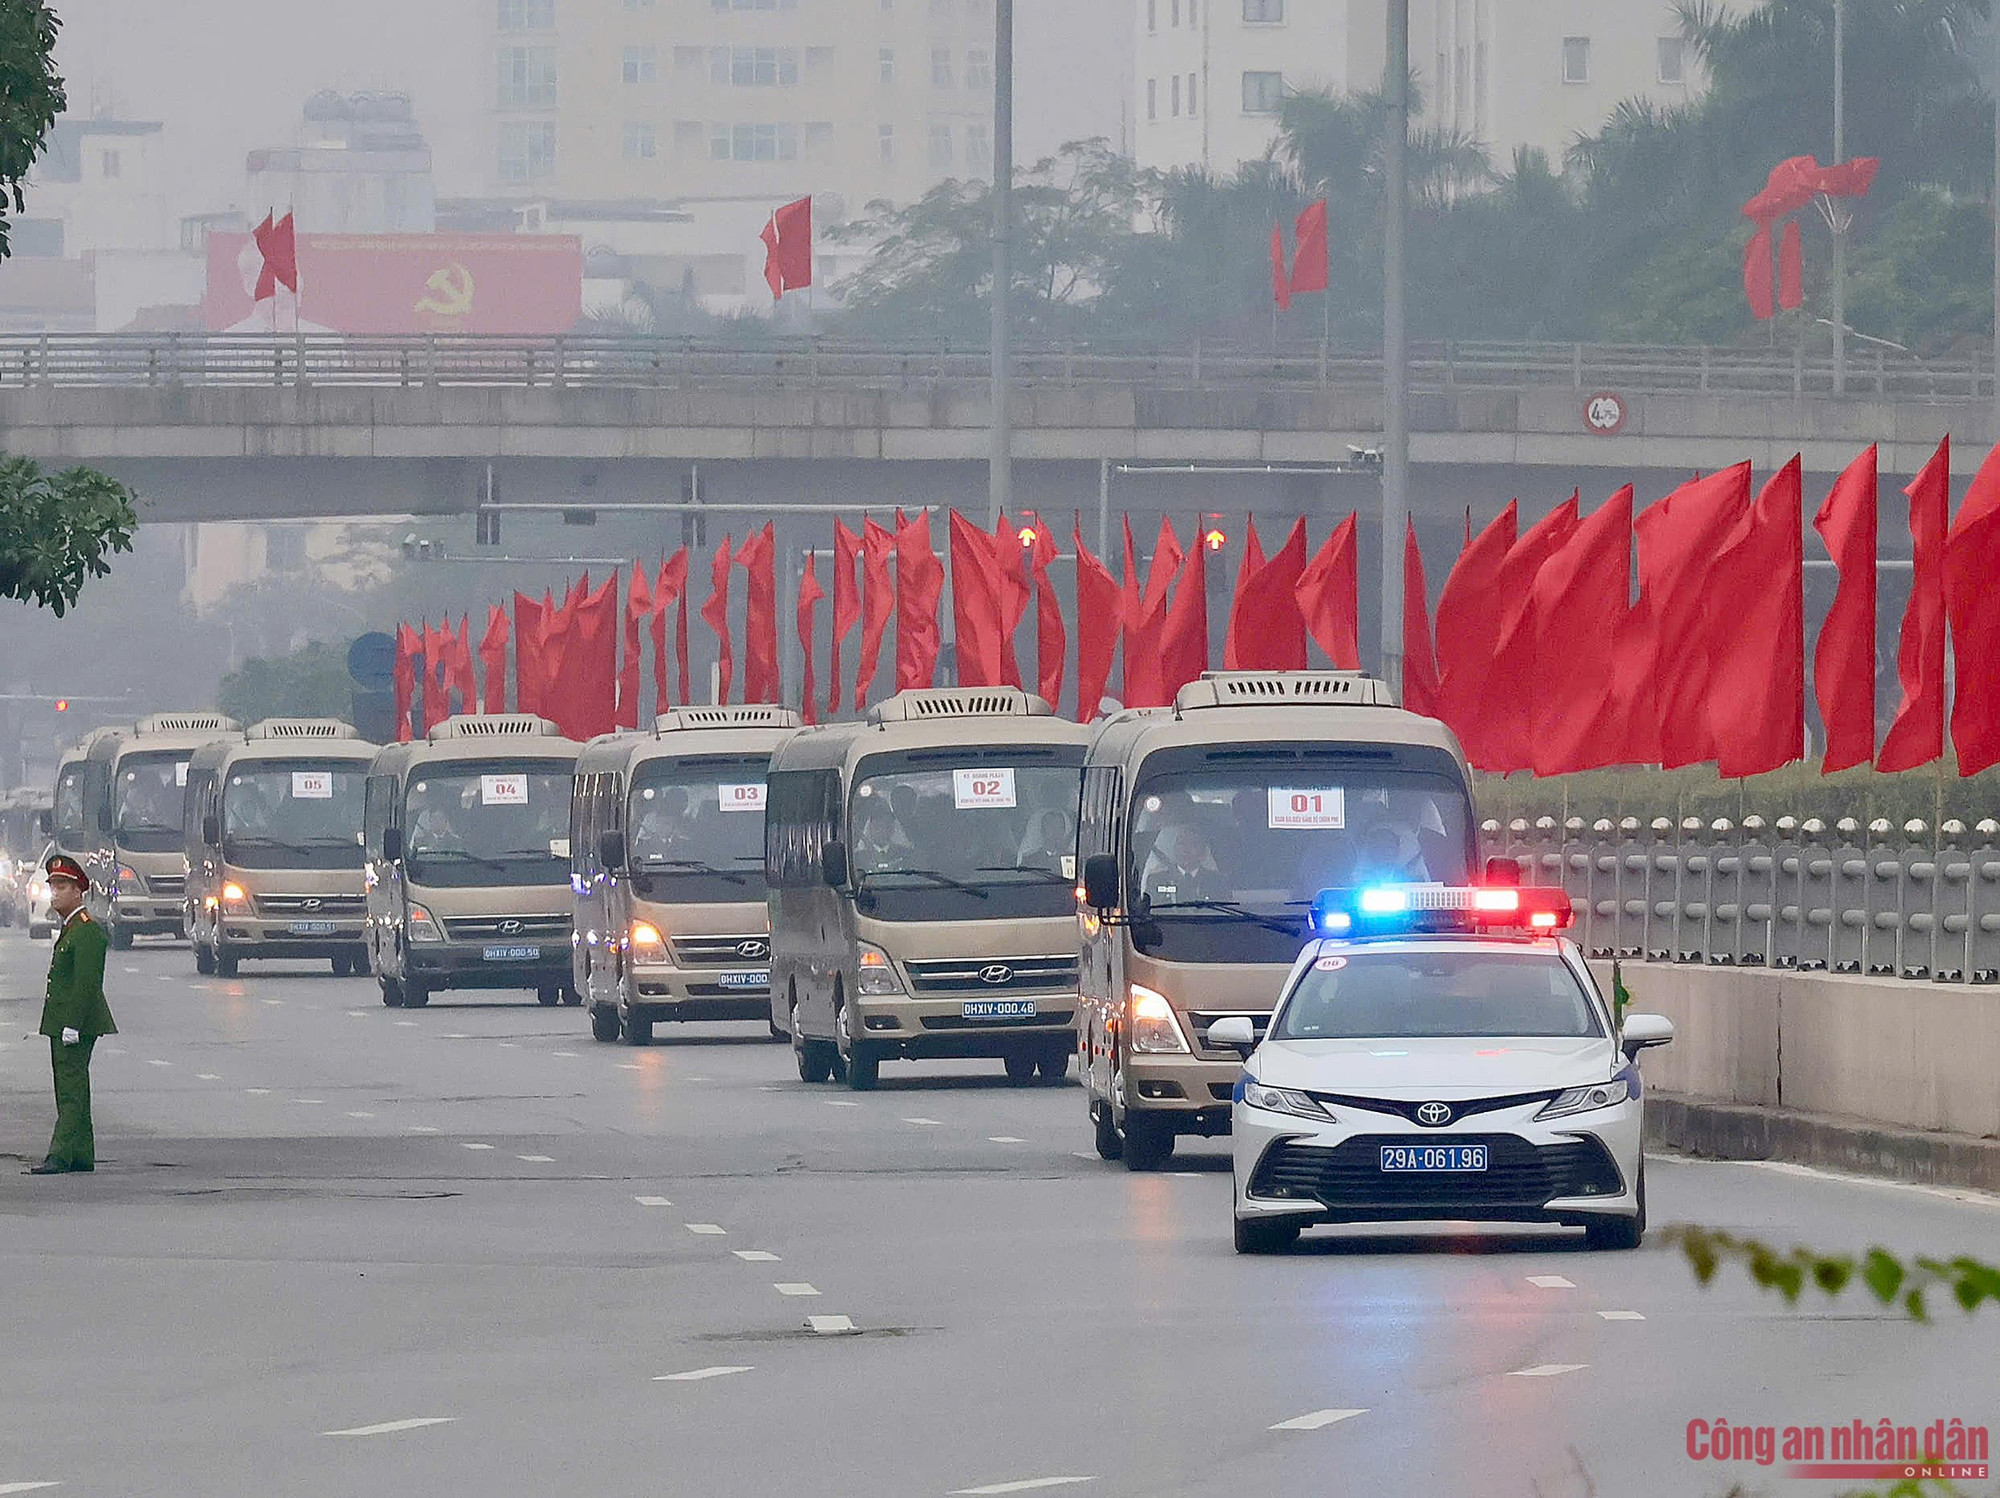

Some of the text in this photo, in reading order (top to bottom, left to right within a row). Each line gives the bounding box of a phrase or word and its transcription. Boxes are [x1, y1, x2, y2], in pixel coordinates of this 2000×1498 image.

[495, 784, 516, 795] 04
[734, 787, 759, 800] 03
[972, 780, 1001, 795] 02
[1291, 794, 1322, 813] 01
[1384, 1148, 1484, 1169] 29A-061.96
